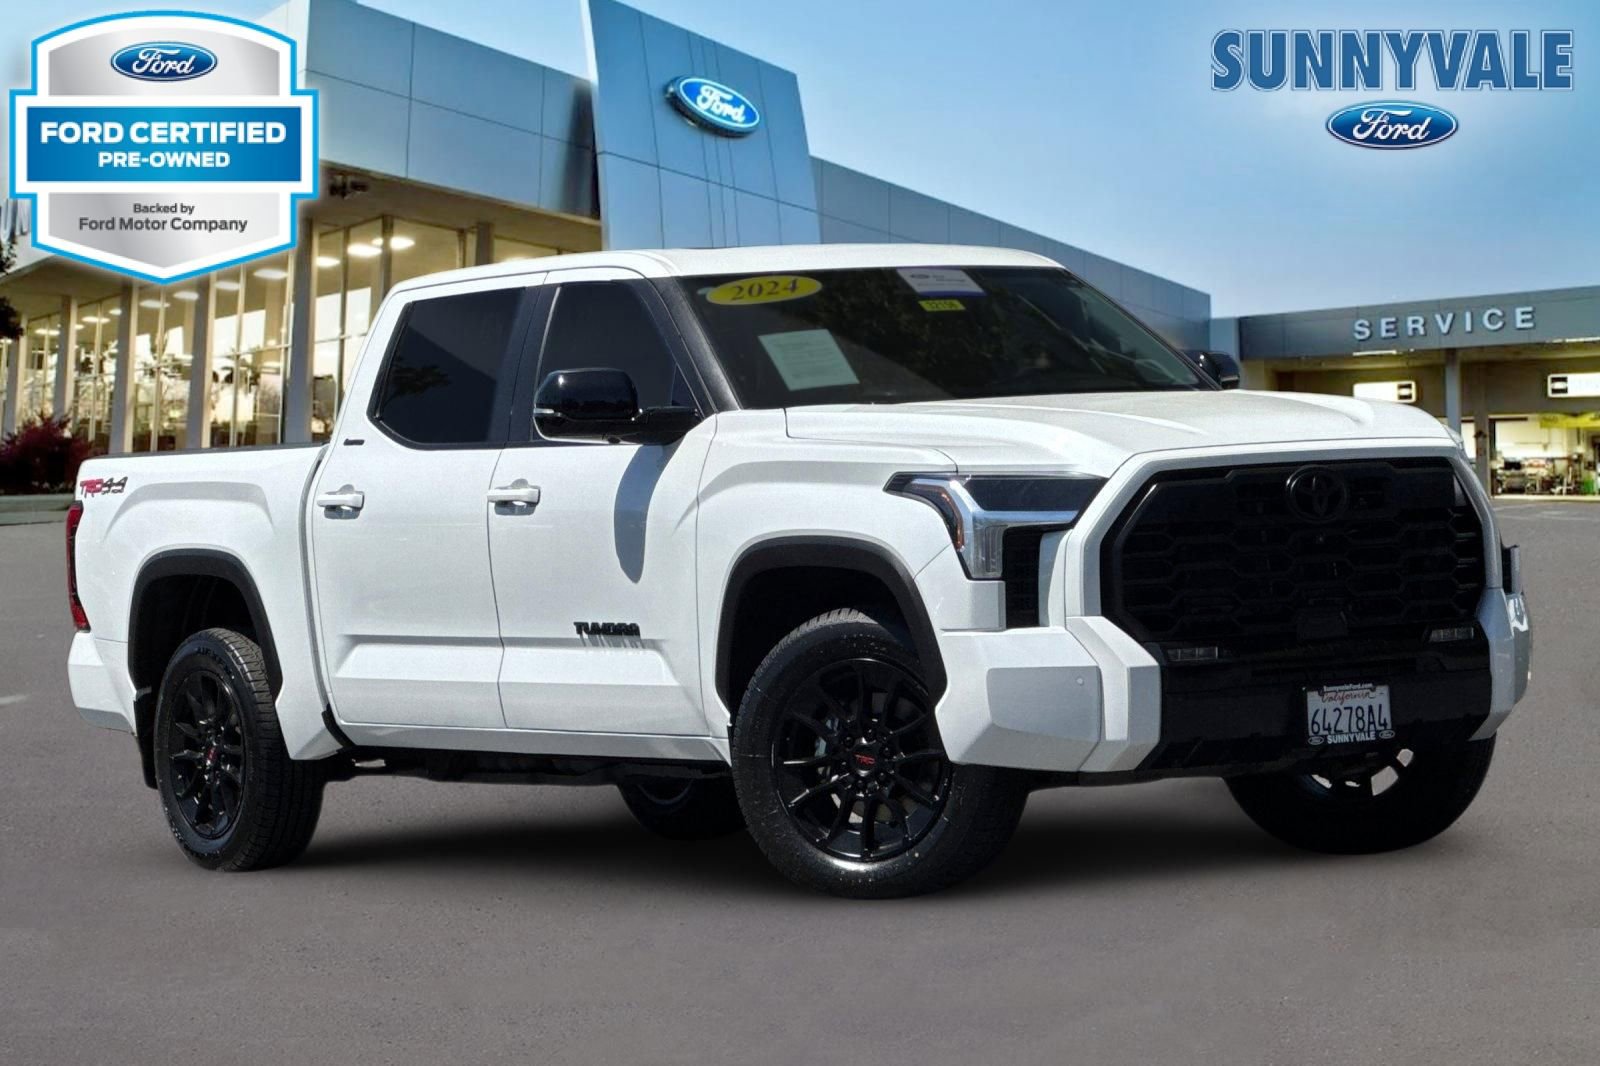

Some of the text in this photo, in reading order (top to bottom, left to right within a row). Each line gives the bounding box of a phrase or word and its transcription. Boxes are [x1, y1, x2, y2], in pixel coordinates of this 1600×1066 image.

[696, 84, 745, 123] Ford
[730, 278, 800, 302] 2024
[1353, 306, 1536, 341] SERVICE
[1311, 703, 1388, 735] 64278A4
[1327, 732, 1376, 744] SUNNYVALE
